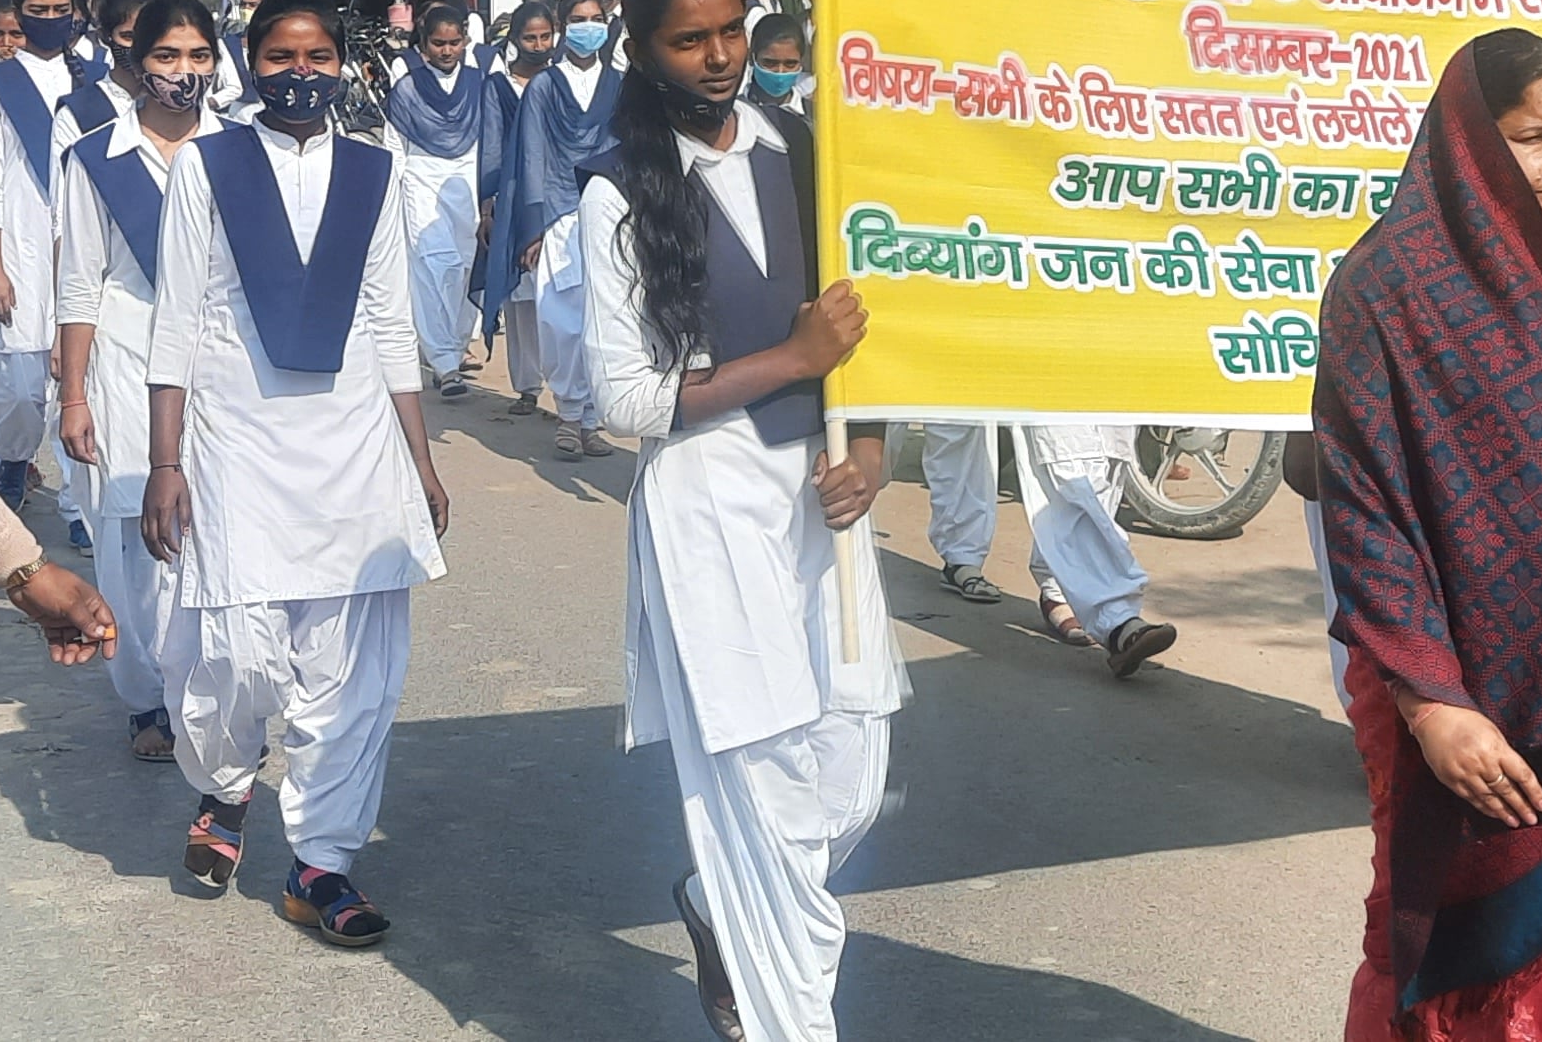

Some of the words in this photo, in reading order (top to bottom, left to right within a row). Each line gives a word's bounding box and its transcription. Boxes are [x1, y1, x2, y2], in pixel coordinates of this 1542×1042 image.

[1034, 70, 1073, 124] के
[1080, 72, 1150, 135] लिए
[1156, 95, 1245, 137] सतत
[1249, 88, 1303, 142] एवं
[1307, 89, 1413, 146] लचीले
[1057, 160, 1166, 205] आप
[1177, 153, 1280, 211] सभी
[1293, 172, 1359, 212] का
[847, 209, 1026, 283] दिव्यांग
[1034, 244, 1130, 286] जन
[1141, 232, 1211, 290] की
[1220, 235, 1316, 293] सेवा
[1214, 316, 1318, 374] सोचि
